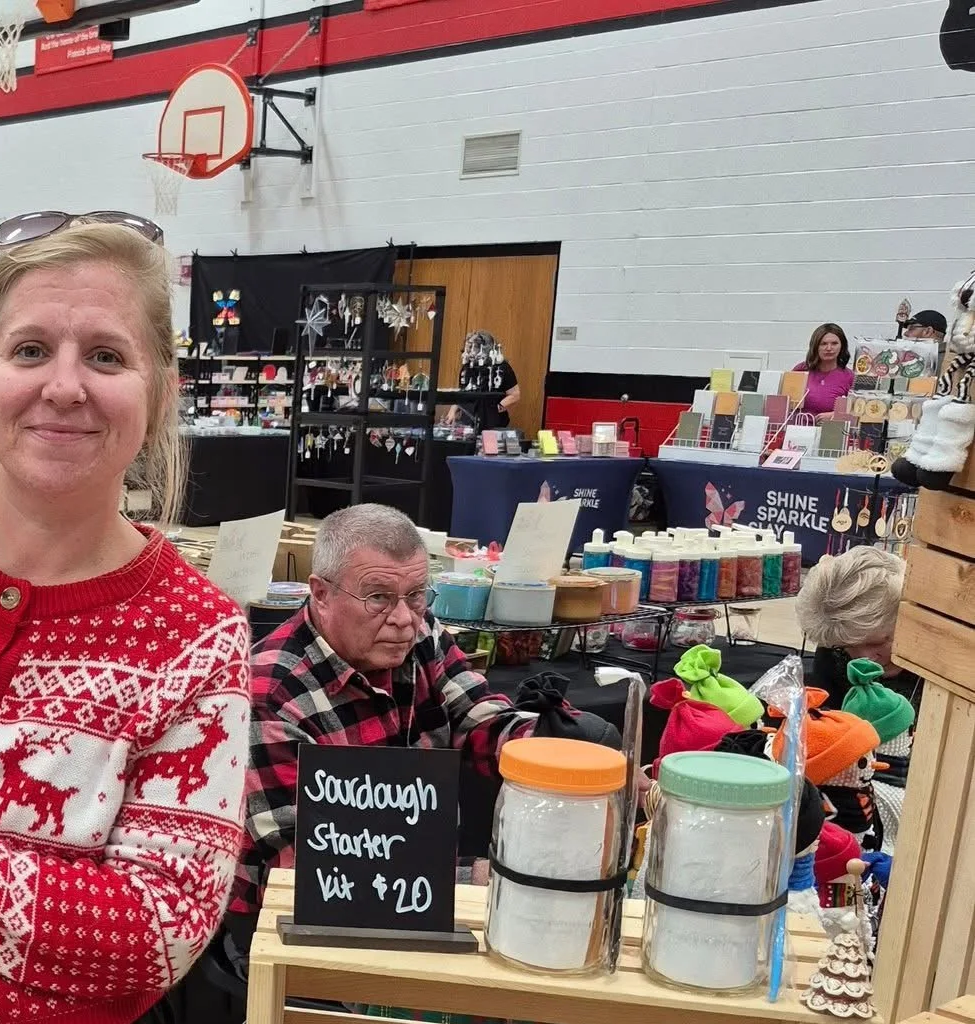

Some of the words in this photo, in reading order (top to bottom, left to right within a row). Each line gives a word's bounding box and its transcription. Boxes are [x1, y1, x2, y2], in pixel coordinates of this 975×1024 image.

[573, 488, 598, 498] SHINE
[766, 490, 819, 513] SHINE
[757, 505, 830, 533] SPARKLE
[304, 769, 438, 826] Sourdough
[306, 822, 406, 860] Starter
[372, 873, 433, 913] $20
